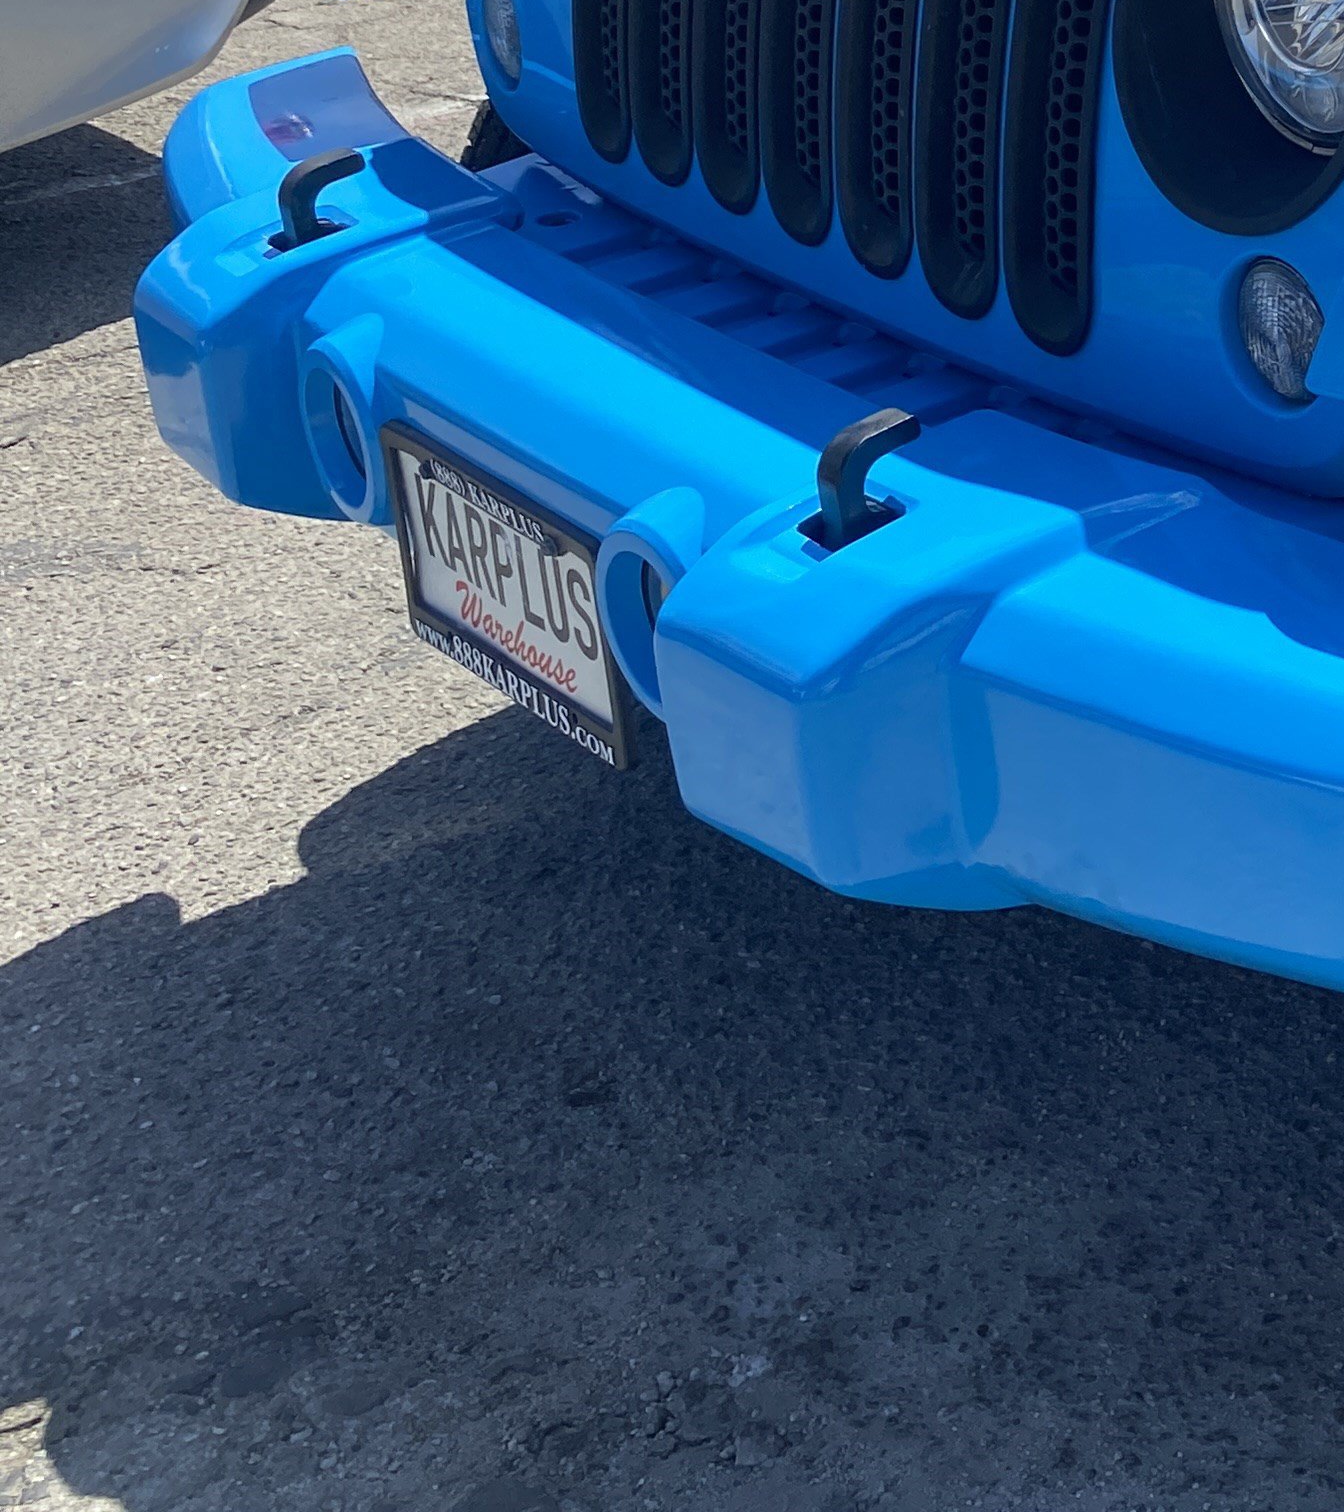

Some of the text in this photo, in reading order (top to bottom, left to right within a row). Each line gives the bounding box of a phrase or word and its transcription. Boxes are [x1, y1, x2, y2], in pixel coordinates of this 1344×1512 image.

[429, 458, 545, 543] (888) KARPLUS
[415, 472, 598, 661] KARPLUS
[456, 580, 578, 694] Warehouse
